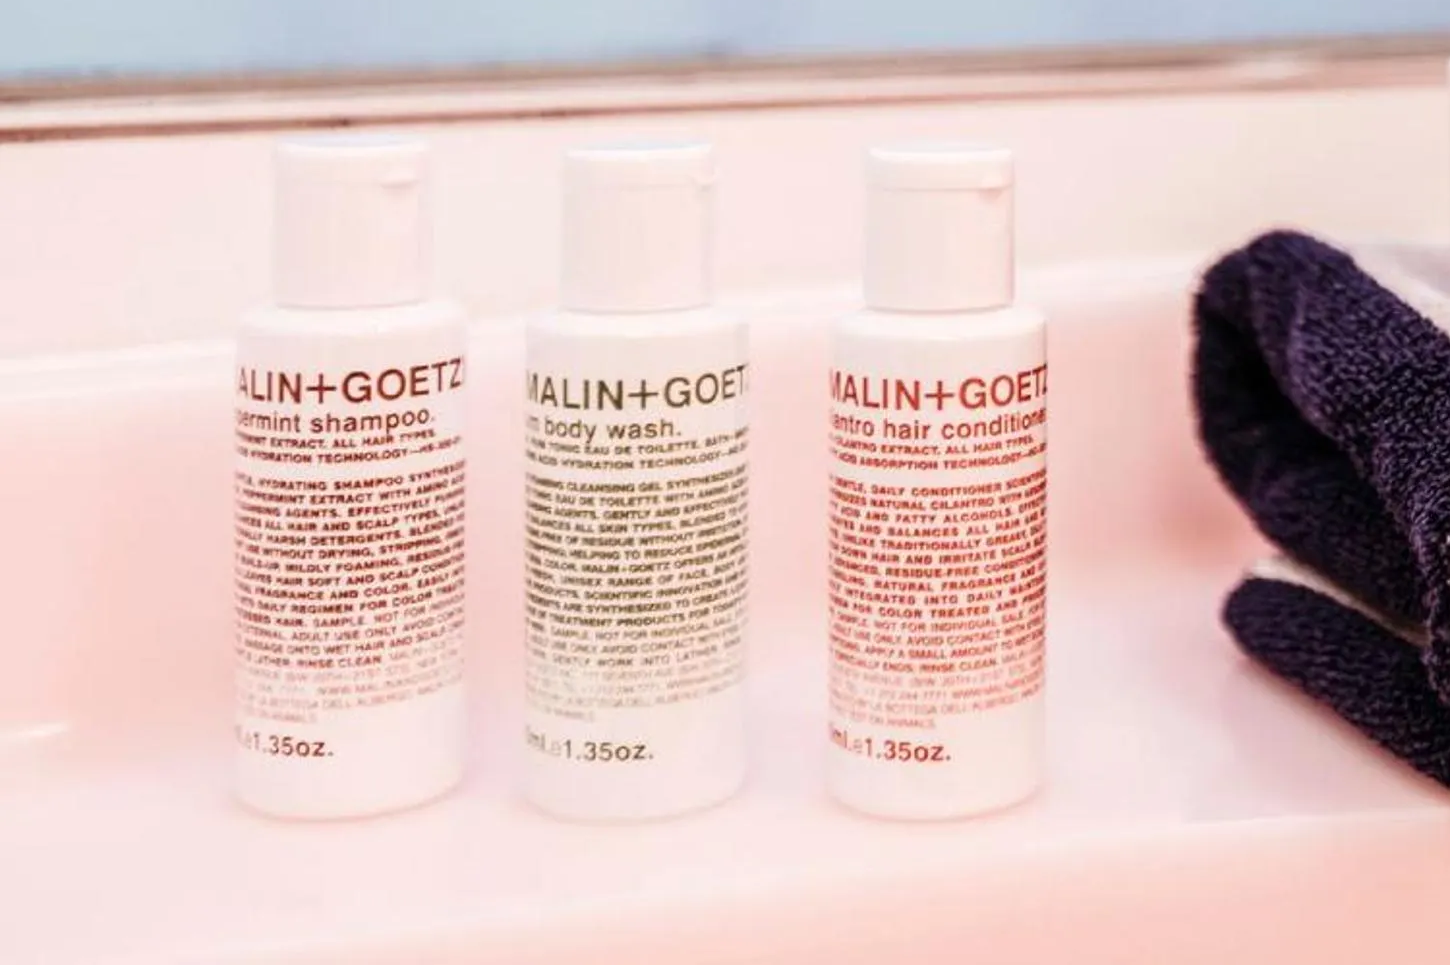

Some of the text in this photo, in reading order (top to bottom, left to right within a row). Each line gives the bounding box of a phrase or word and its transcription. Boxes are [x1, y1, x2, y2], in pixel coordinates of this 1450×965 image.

[310, 408, 435, 436] shampoo.
[545, 414, 597, 445] body
[607, 418, 682, 439] wash.
[883, 418, 931, 440] hair
[332, 438, 356, 448] ALL
[946, 445, 969, 454] ALL
[334, 476, 404, 490] SHAMPOO
[871, 482, 1003, 497] DAILY CONDITIONER
[310, 493, 373, 504] EXTRACT
[380, 489, 411, 500] WITH
[870, 498, 926, 511] NATURAL
[930, 496, 995, 511] CILANTRO
[322, 521, 350, 531] AND
[356, 516, 399, 530] SCALP
[895, 513, 937, 524] FATTY
[886, 526, 960, 537] BALANCES
[966, 524, 990, 536] ALL
[880, 538, 982, 551] TRADITIONALLY
[871, 552, 900, 563] HAIR
[905, 554, 934, 565] AND
[938, 548, 997, 564] IRRITATE
[308, 577, 341, 587] SOFT
[347, 574, 375, 585] AND
[379, 567, 419, 583] SCALP
[873, 581, 933, 593] NATURAL
[940, 574, 1017, 592] FRAGRANCE
[330, 590, 359, 599] AND
[359, 600, 388, 612] FOR
[391, 591, 433, 608] COLOR
[923, 593, 959, 605] INTO
[965, 590, 1003, 604] DAILY
[878, 606, 923, 619] COLOR
[930, 605, 990, 619] TREATED
[995, 598, 1018, 613] AND
